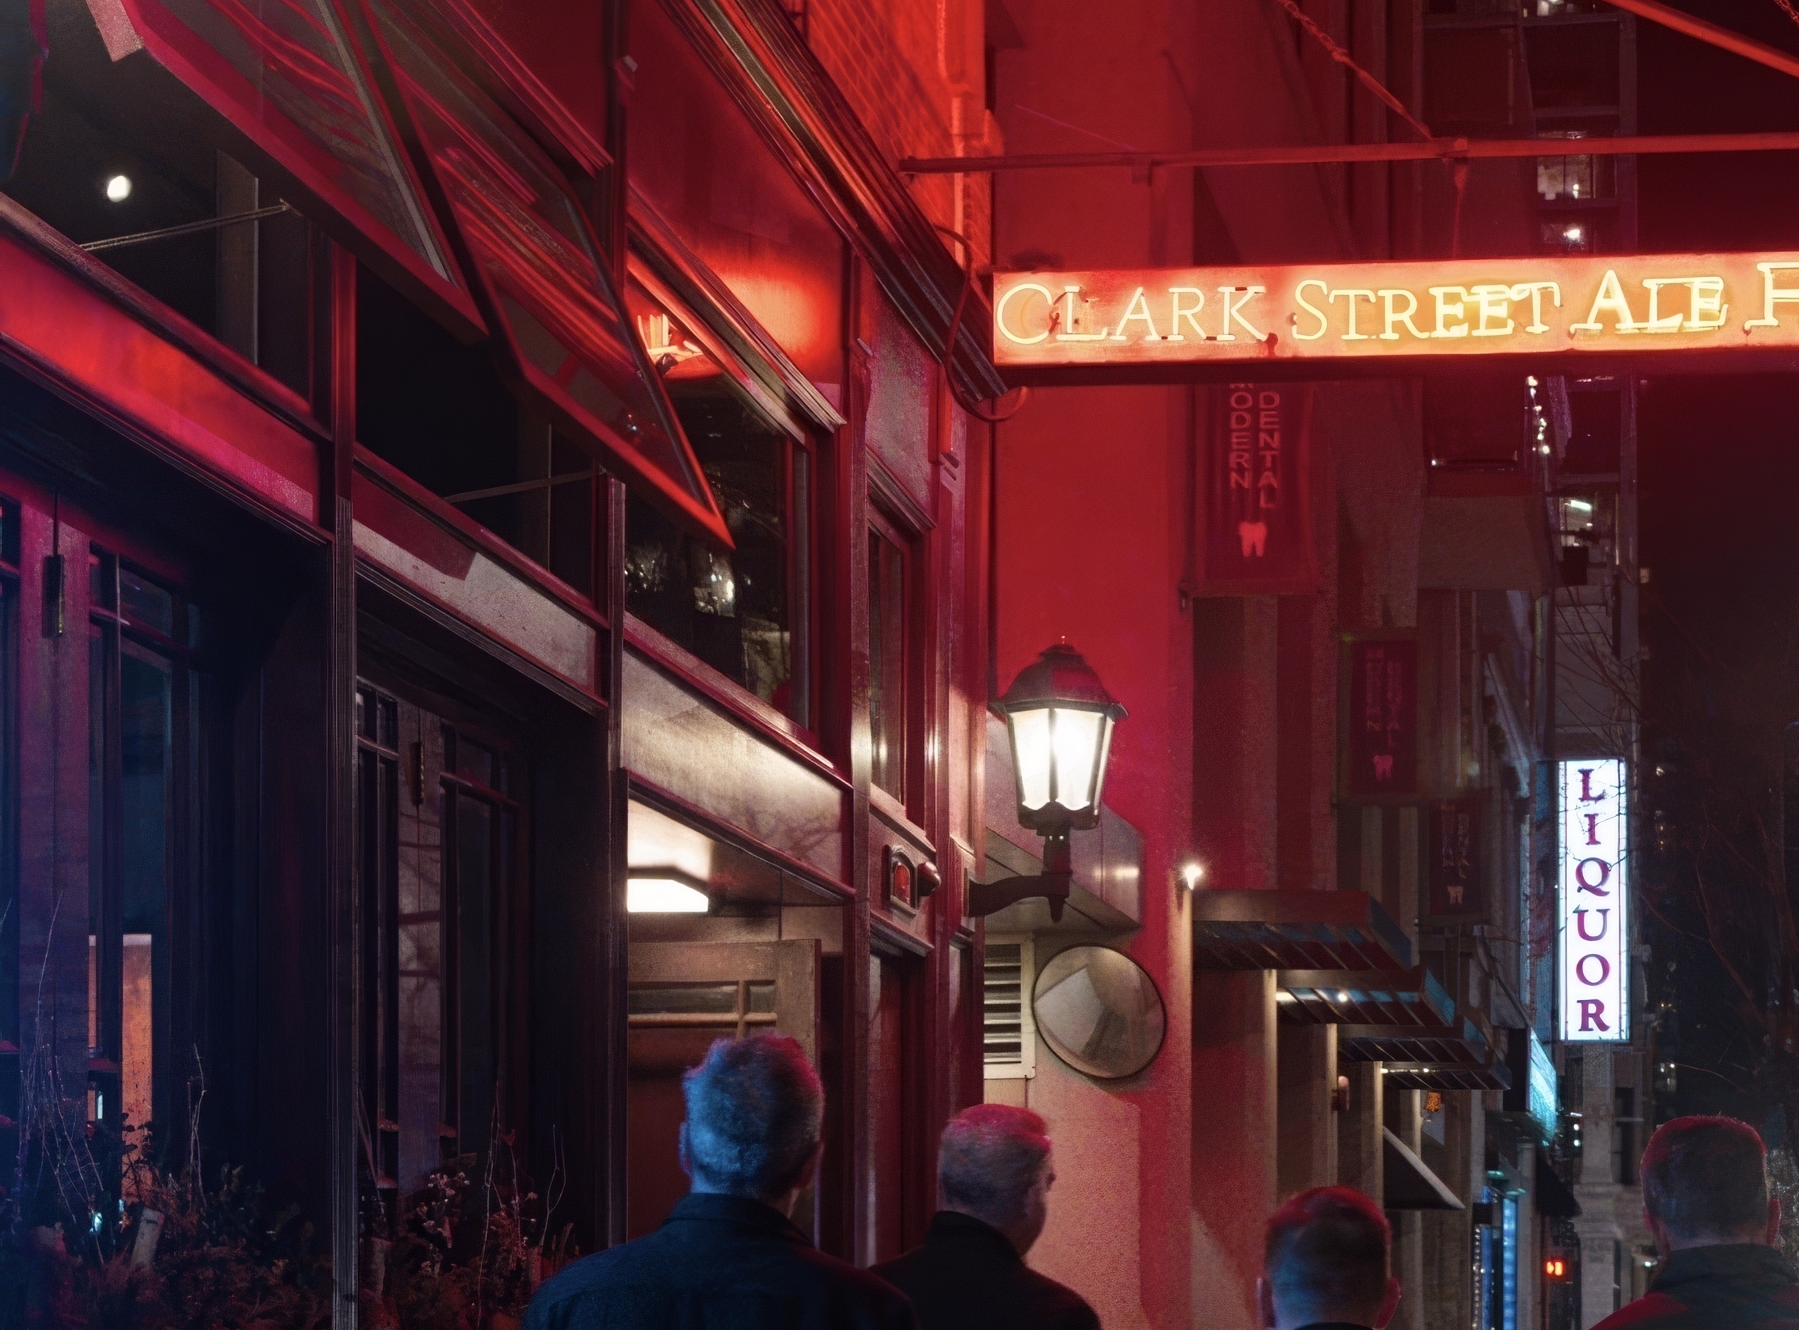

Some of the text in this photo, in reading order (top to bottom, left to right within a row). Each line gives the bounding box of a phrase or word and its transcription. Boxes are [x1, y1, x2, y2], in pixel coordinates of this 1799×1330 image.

[997, 284, 1267, 347] CLARK
[1291, 276, 1561, 340] STREET
[1570, 268, 1729, 334] ALE
[1229, 383, 1253, 489] ODERN
[1258, 391, 1280, 508] DENTAL
[1574, 768, 1611, 1035] LIQUOR
